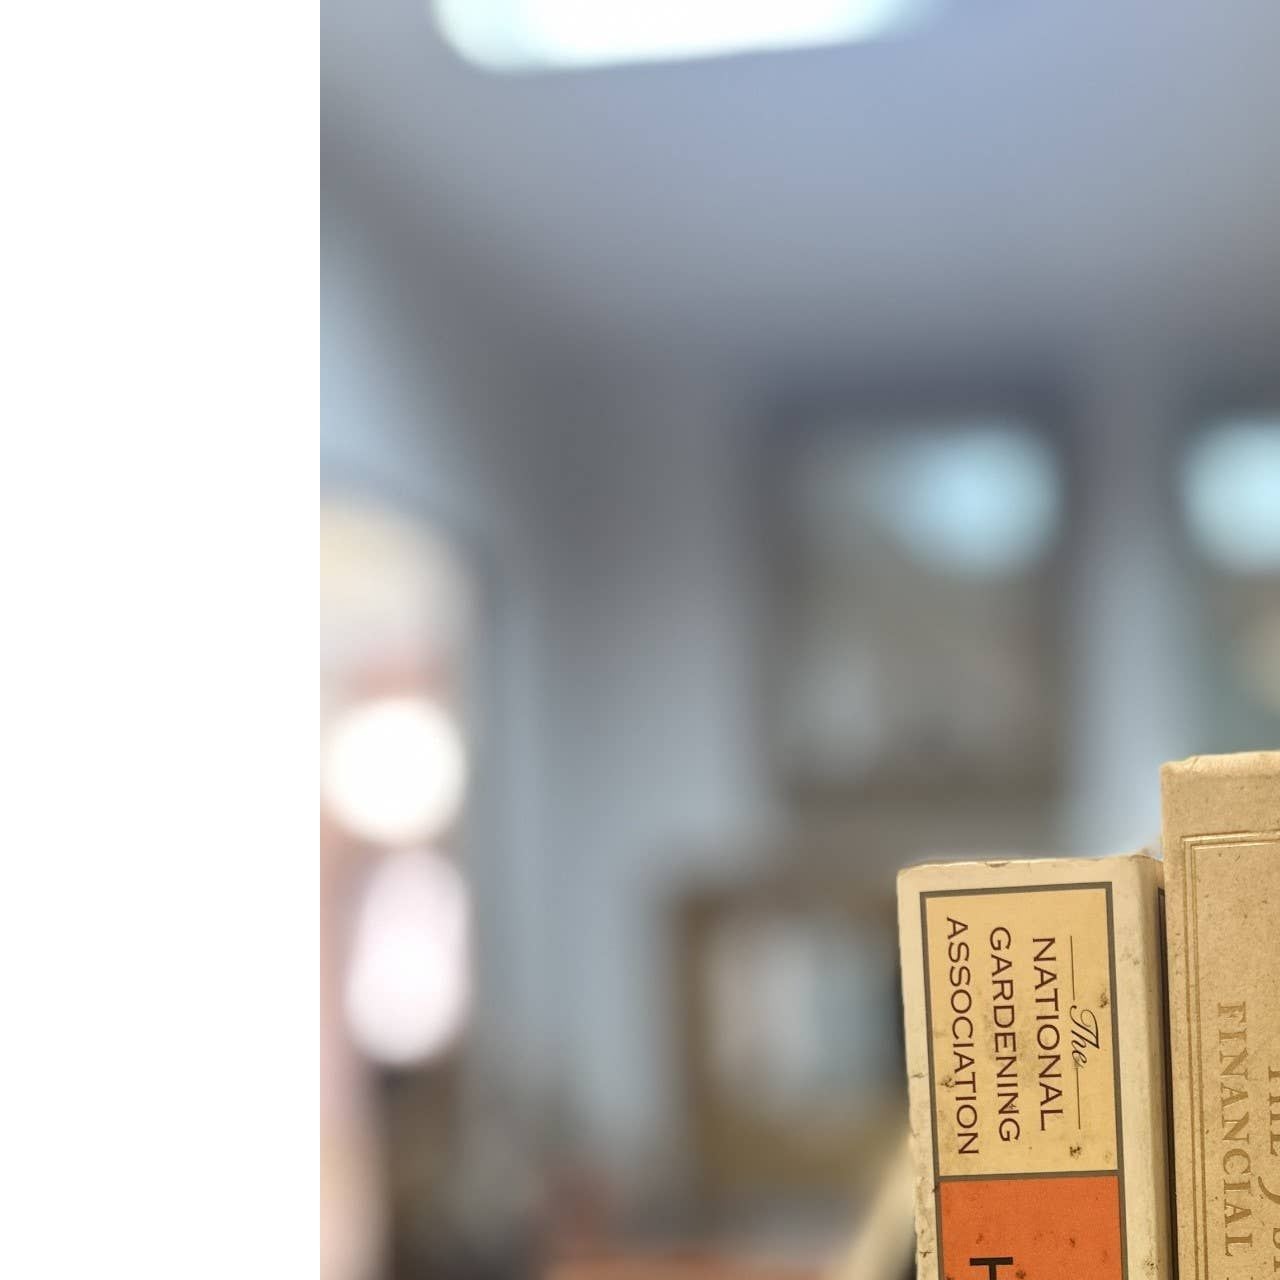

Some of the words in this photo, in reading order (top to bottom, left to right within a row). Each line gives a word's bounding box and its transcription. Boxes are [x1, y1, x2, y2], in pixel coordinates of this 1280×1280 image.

[946, 916, 980, 1154] ASSOCIATION
[989, 926, 1021, 1142] GARDENING
[1032, 936, 1064, 1131] NATIONAL
[1069, 1005, 1100, 1067] The
[1217, 1001, 1254, 1257] FINANCIAL
